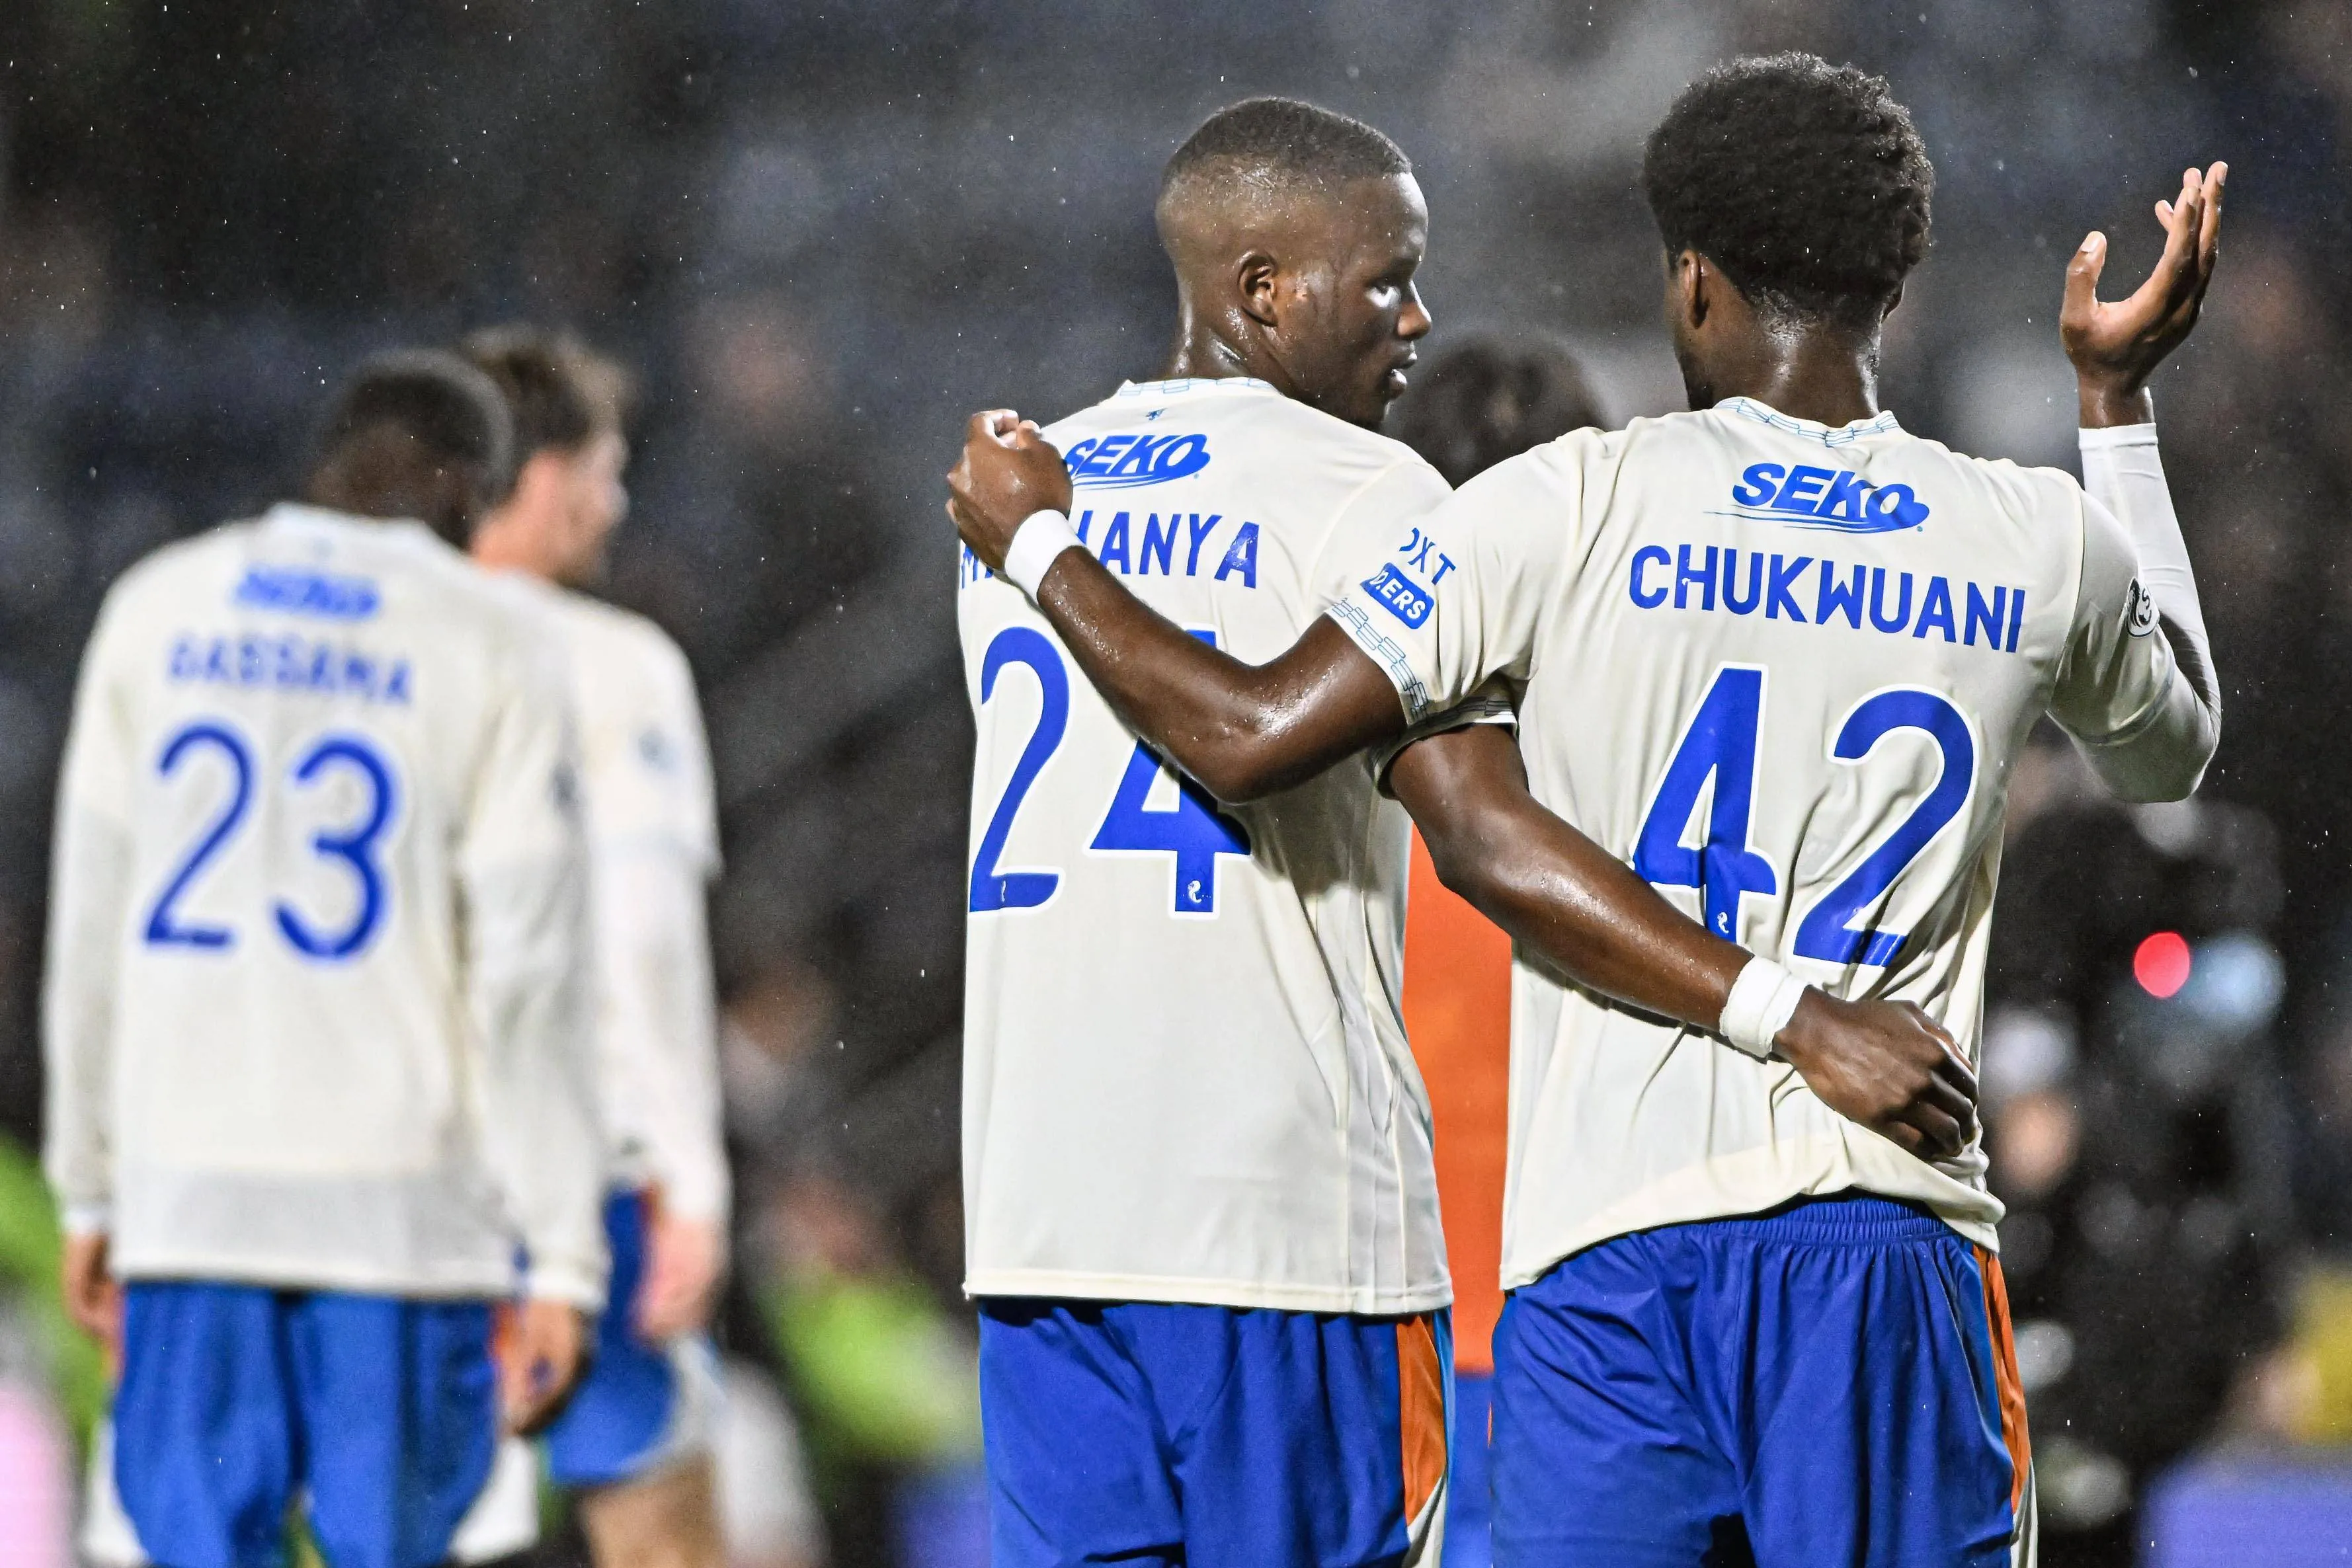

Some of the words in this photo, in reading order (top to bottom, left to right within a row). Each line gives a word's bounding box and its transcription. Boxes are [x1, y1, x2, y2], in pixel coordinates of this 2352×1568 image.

[1063, 434, 1211, 483] SEKO
[1731, 463, 1929, 533] SEKO
[961, 510, 1260, 589] MANYA
[1629, 544, 2025, 652] CHUKWUANI
[969, 626, 1251, 912] 24
[1631, 668, 1974, 967] 42
[142, 721, 399, 962] 23
